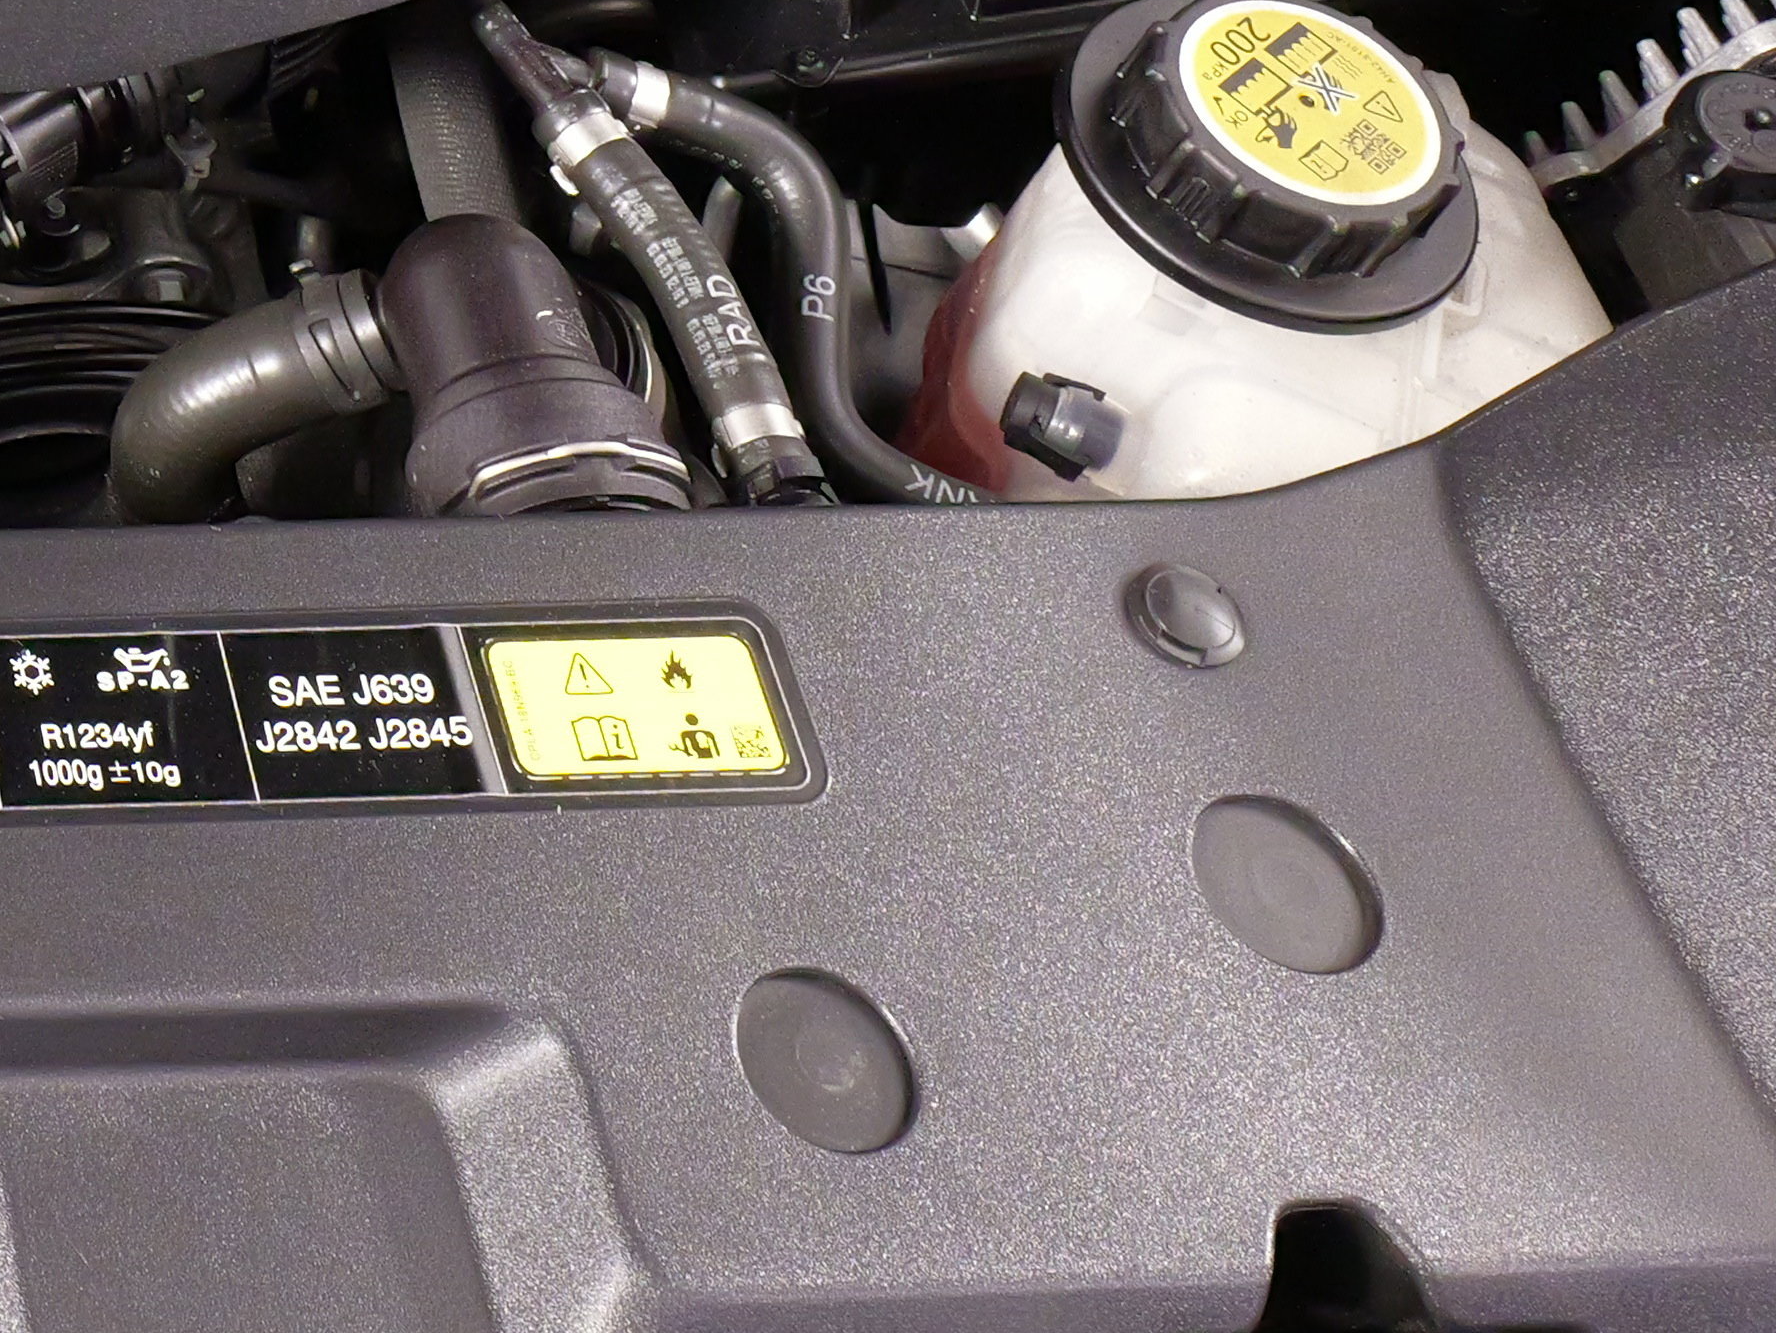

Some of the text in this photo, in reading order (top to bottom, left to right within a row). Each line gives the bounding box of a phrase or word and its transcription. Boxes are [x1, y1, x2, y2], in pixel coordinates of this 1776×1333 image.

[1210, 16, 1271, 66] 200
[1225, 109, 1249, 129] OK
[706, 274, 762, 348] RAD
[800, 273, 837, 321] P6
[96, 669, 190, 692] SP-A2
[268, 673, 435, 707] SAE J639
[40, 720, 154, 753] R1234yf
[255, 715, 474, 753] J2842 J2845
[28, 758, 104, 791] 1000g
